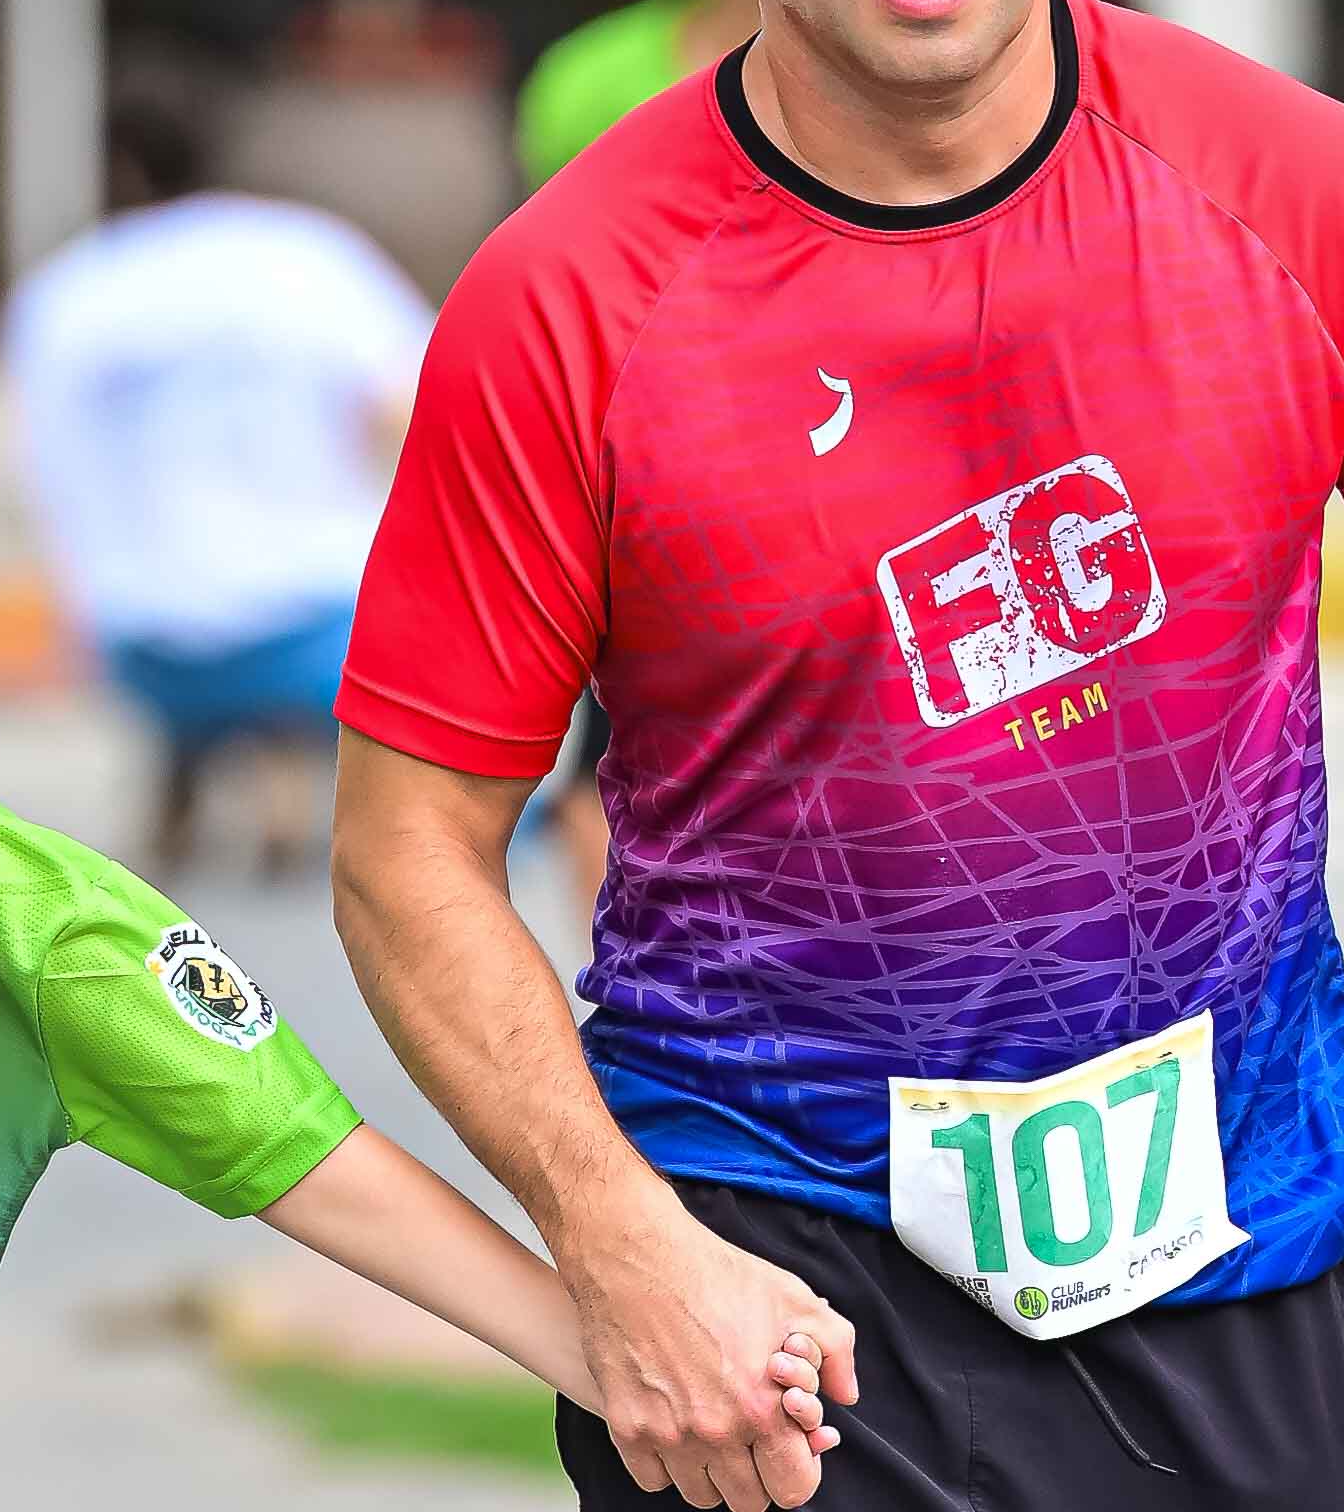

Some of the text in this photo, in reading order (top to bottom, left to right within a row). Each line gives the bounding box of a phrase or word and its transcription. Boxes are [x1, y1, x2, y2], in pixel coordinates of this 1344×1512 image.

[887, 472, 1153, 711] FG
[1003, 681, 1109, 751] TEAM
[931, 1057, 1181, 1273] 107
[1051, 1281, 1084, 1299] CLUB
